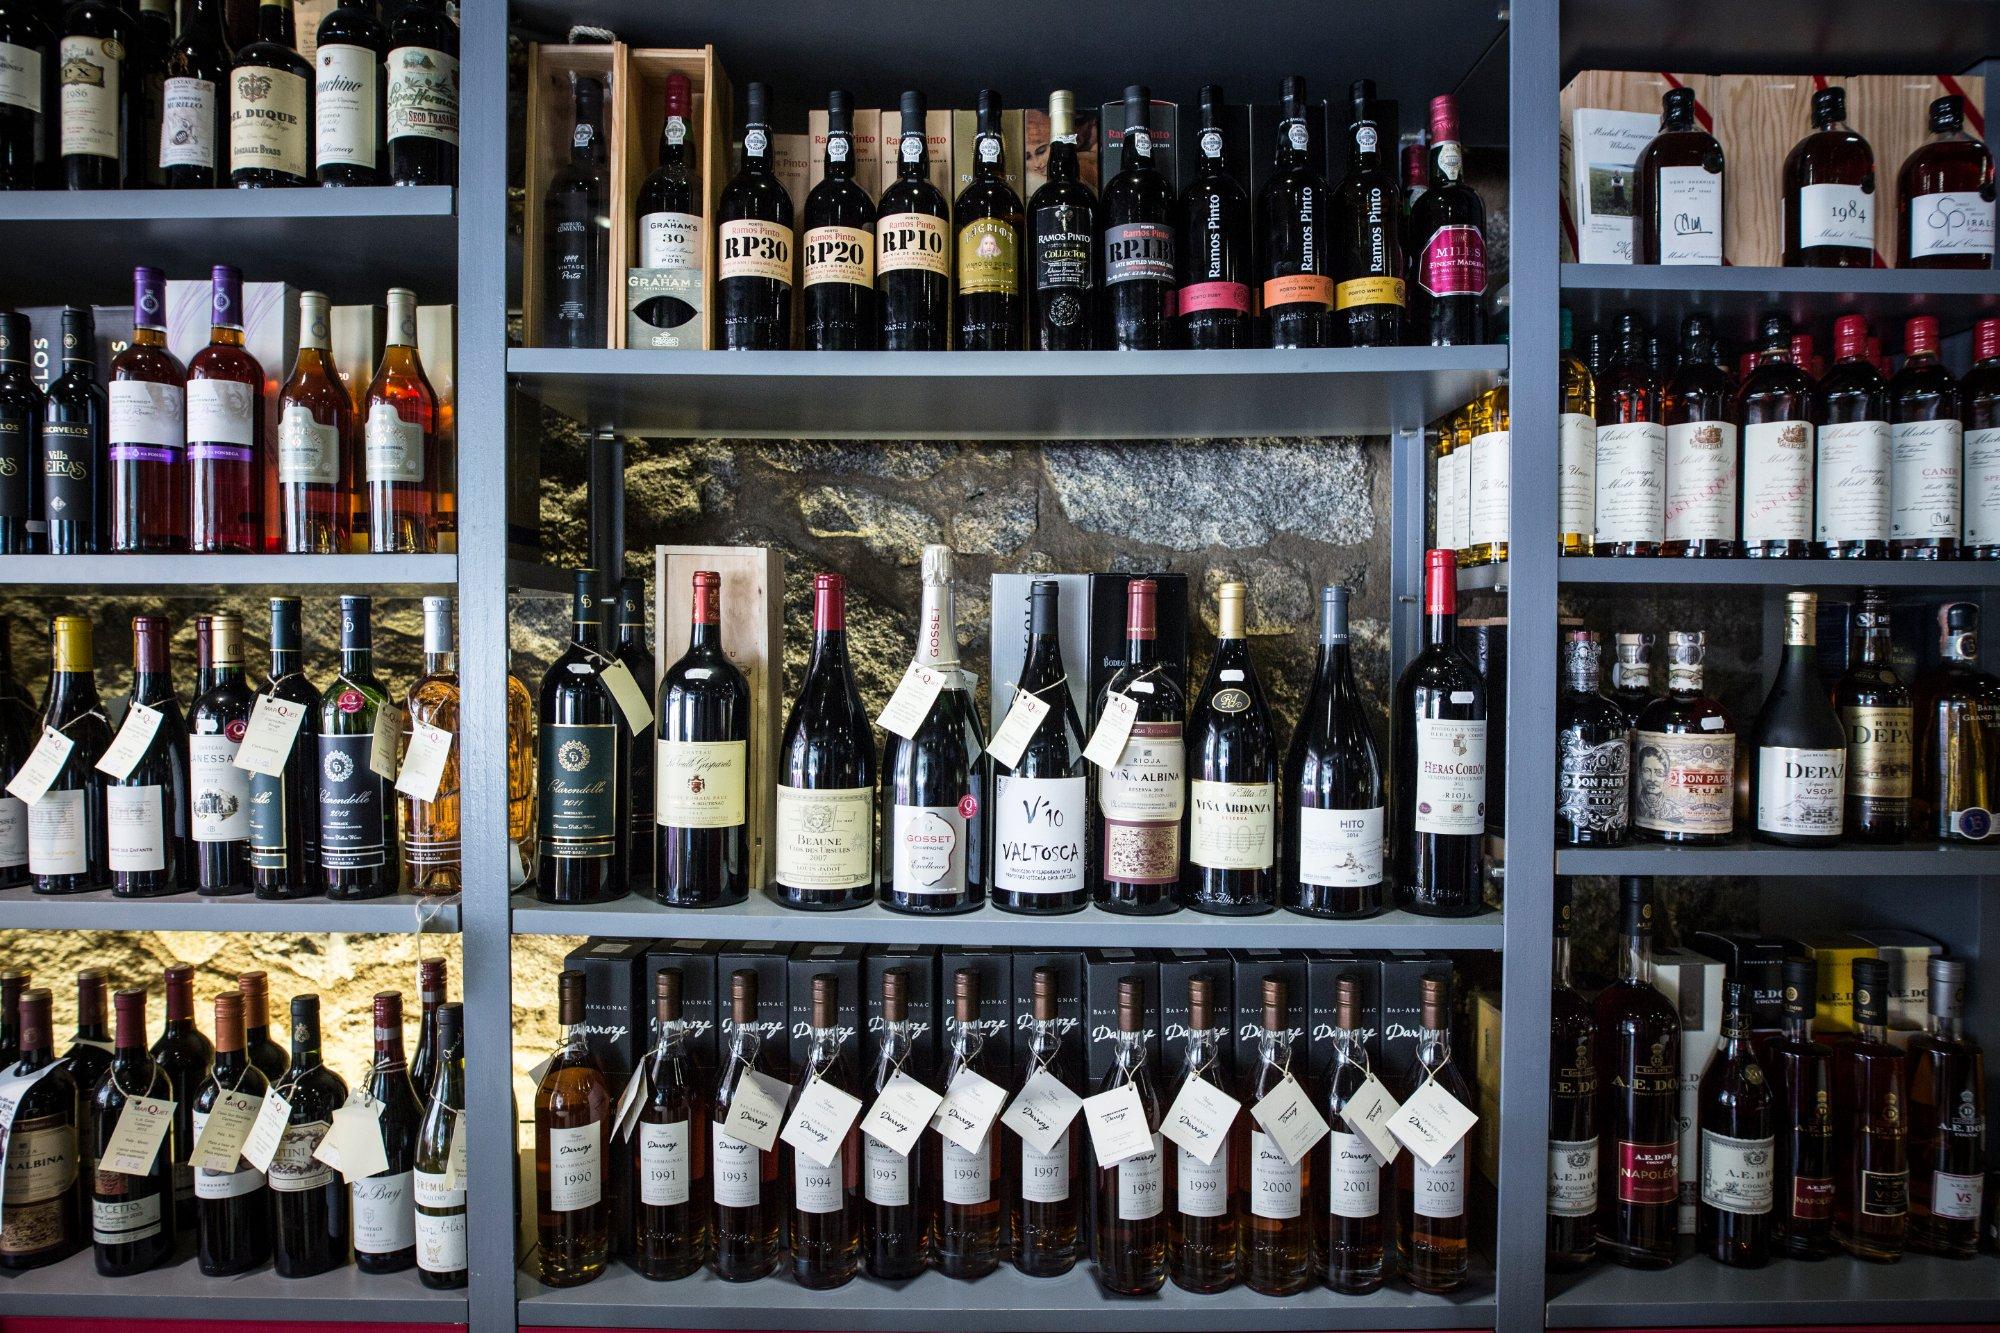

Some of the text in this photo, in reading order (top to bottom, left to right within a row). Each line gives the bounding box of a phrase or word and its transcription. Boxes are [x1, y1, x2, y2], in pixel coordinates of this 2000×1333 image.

[246, 108, 297, 126] DUQUE
[408, 110, 426, 123] SECO
[1831, 199, 1866, 223] 1984
[889, 219, 936, 231] Ramos Pinto
[1300, 186, 1313, 272] Ramos Pinto
[1370, 187, 1382, 272] Ramos Pinto
[662, 233, 685, 244] 30
[732, 226, 780, 238] Ramos Pinto
[810, 232, 856, 243] Ramos Pinto
[1038, 232, 1090, 243] RAMOS PINTO
[1123, 228, 1149, 238] Ramos
[1208, 193, 1221, 278] Ramos Pinto
[882, 229, 942, 254] RP10
[724, 236, 788, 263] RP30
[805, 241, 864, 267] RP20
[48, 450, 69, 460] Villa
[45, 460, 87, 480] EIRAS
[931, 606, 939, 658] GOSSET
[1852, 725, 1911, 744] DEPA
[1424, 761, 1454, 775] HERAS
[1785, 761, 1844, 779] DEPAZ
[1140, 771, 1180, 782] ALBINA
[1601, 774, 1624, 787] PAPA
[1689, 786, 1724, 794] RUM
[1805, 787, 1834, 795] VSOP
[1196, 798, 1271, 813] VIÑA ARDANZA
[1340, 819, 1365, 829] HITO
[797, 833, 842, 846] BEAUNE
[906, 834, 952, 843] GOSSET
[809, 854, 828, 862] 2007
[1002, 841, 1079, 862] VALTOSCA
[1654, 1078, 1677, 1091] DO
[560, 1142, 593, 1155] Darroze
[647, 1140, 679, 1150] Darroze
[718, 1140, 749, 1151] Darroze
[1340, 1150, 1372, 1161] Darroze
[17, 1154, 65, 1171] ALBINA
[563, 1171, 592, 1186] 1990
[650, 1170, 676, 1182] 1991
[722, 1171, 748, 1182] 1993
[872, 1169, 897, 1181] 1995
[953, 1168, 980, 1180] 1996
[1033, 1166, 1060, 1178] 1997
[805, 1176, 831, 1188] 1994
[1132, 1181, 1157, 1195] 1998
[1189, 1180, 1217, 1192] 1999
[1262, 1180, 1292, 1193] 2000
[1343, 1180, 1371, 1193] 2001
[1426, 1180, 1456, 1193] 2002
[369, 1182, 402, 1204] Bay
[1955, 1192, 1972, 1203] VS
